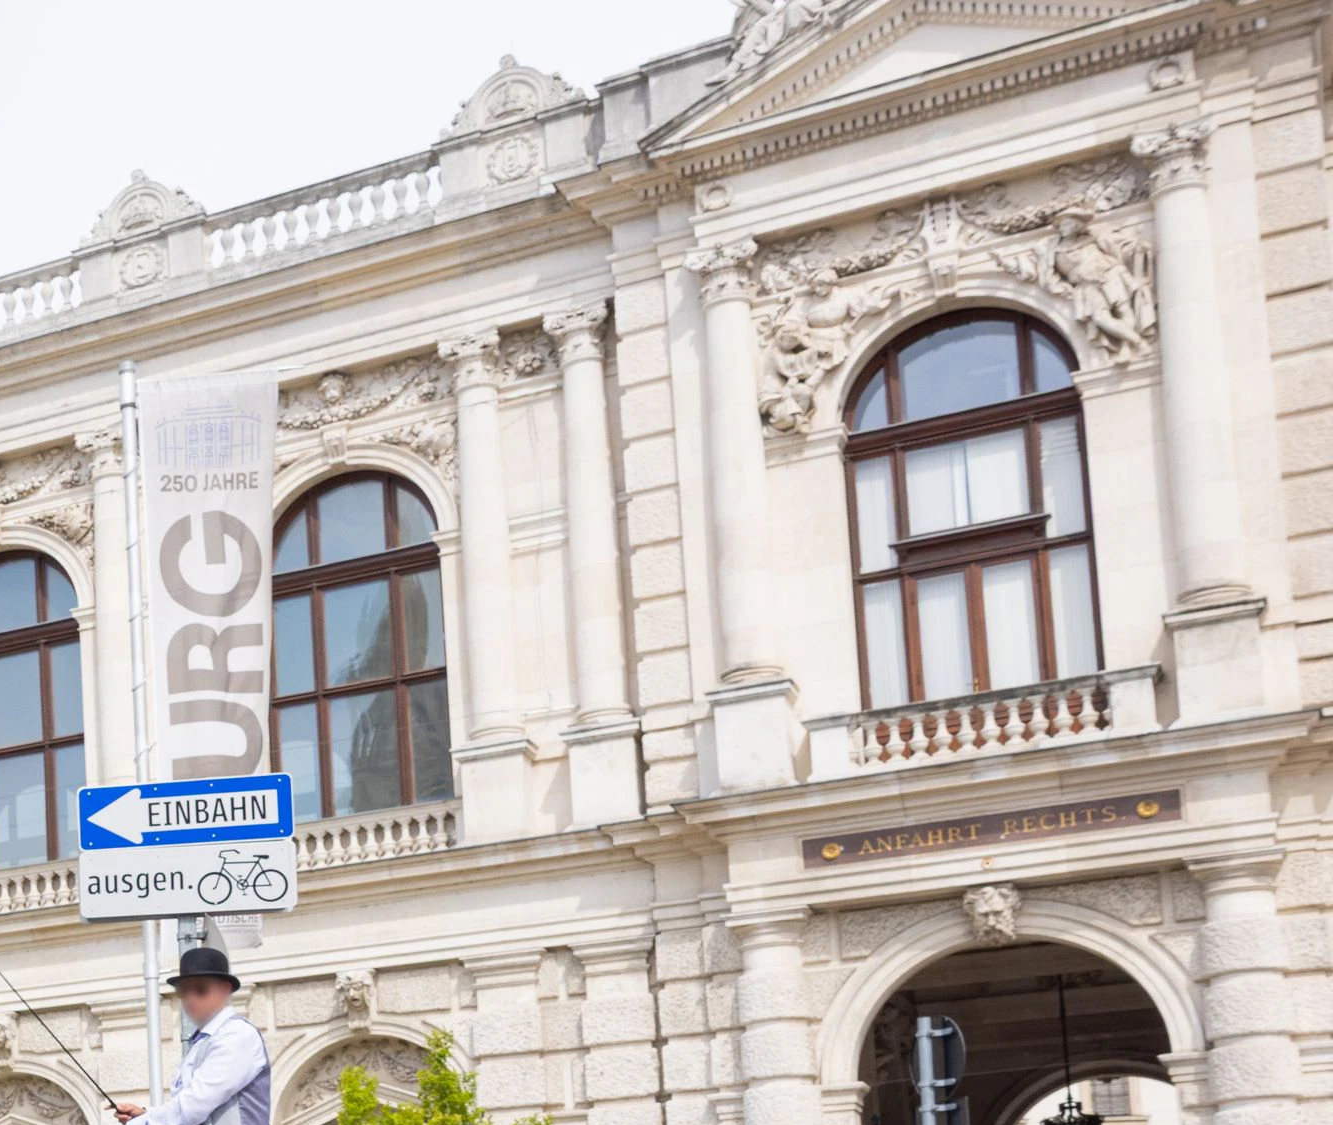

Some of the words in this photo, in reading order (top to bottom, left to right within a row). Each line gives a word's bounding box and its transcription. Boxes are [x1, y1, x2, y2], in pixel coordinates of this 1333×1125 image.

[160, 474, 198, 493] 250
[203, 471, 260, 492] JAHRE
[148, 794, 267, 828] EINBAHN
[858, 823, 982, 856] ANFAHRT
[1003, 805, 1127, 836] RECHTS.
[88, 871, 193, 899] ausgen.
